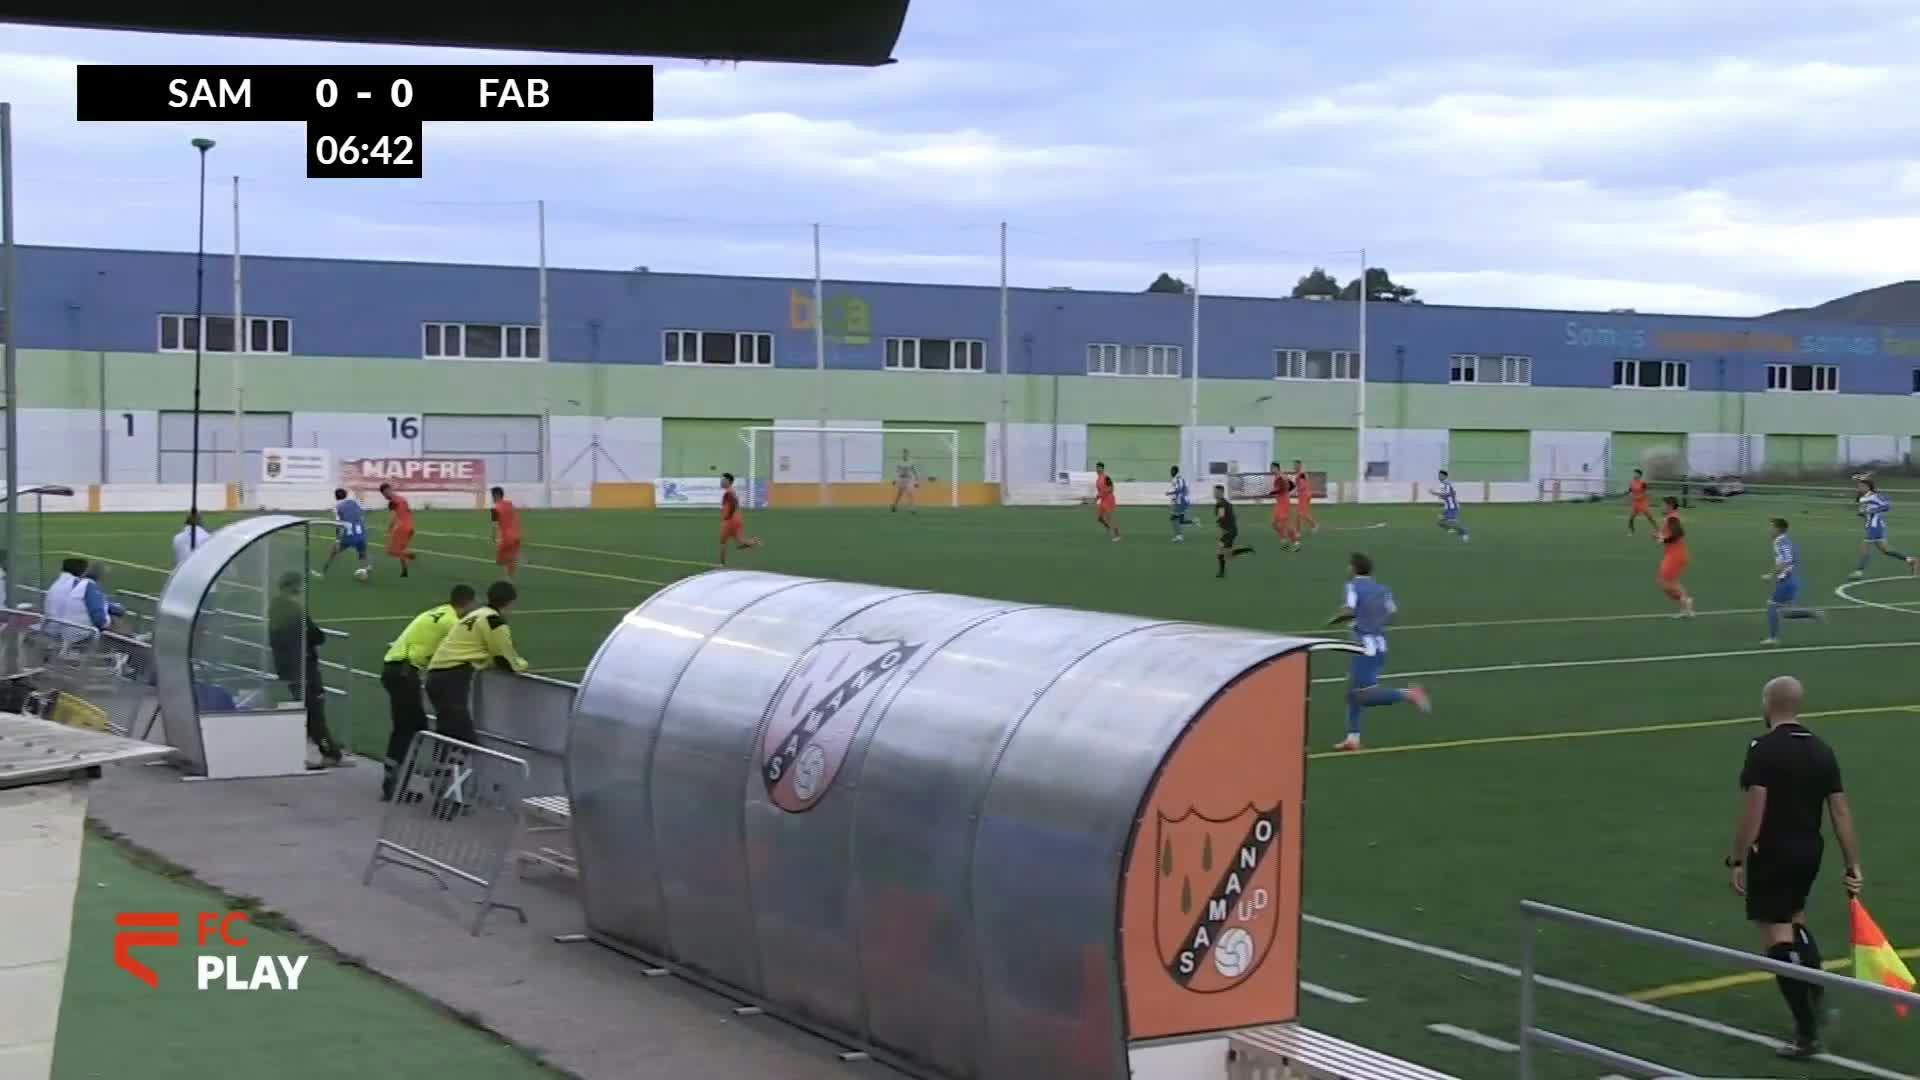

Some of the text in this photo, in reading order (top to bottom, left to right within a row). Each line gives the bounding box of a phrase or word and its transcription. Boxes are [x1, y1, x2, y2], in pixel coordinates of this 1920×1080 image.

[122, 413, 135, 437] 1
[387, 416, 419, 440] 16
[361, 460, 473, 479] MAPFRE
